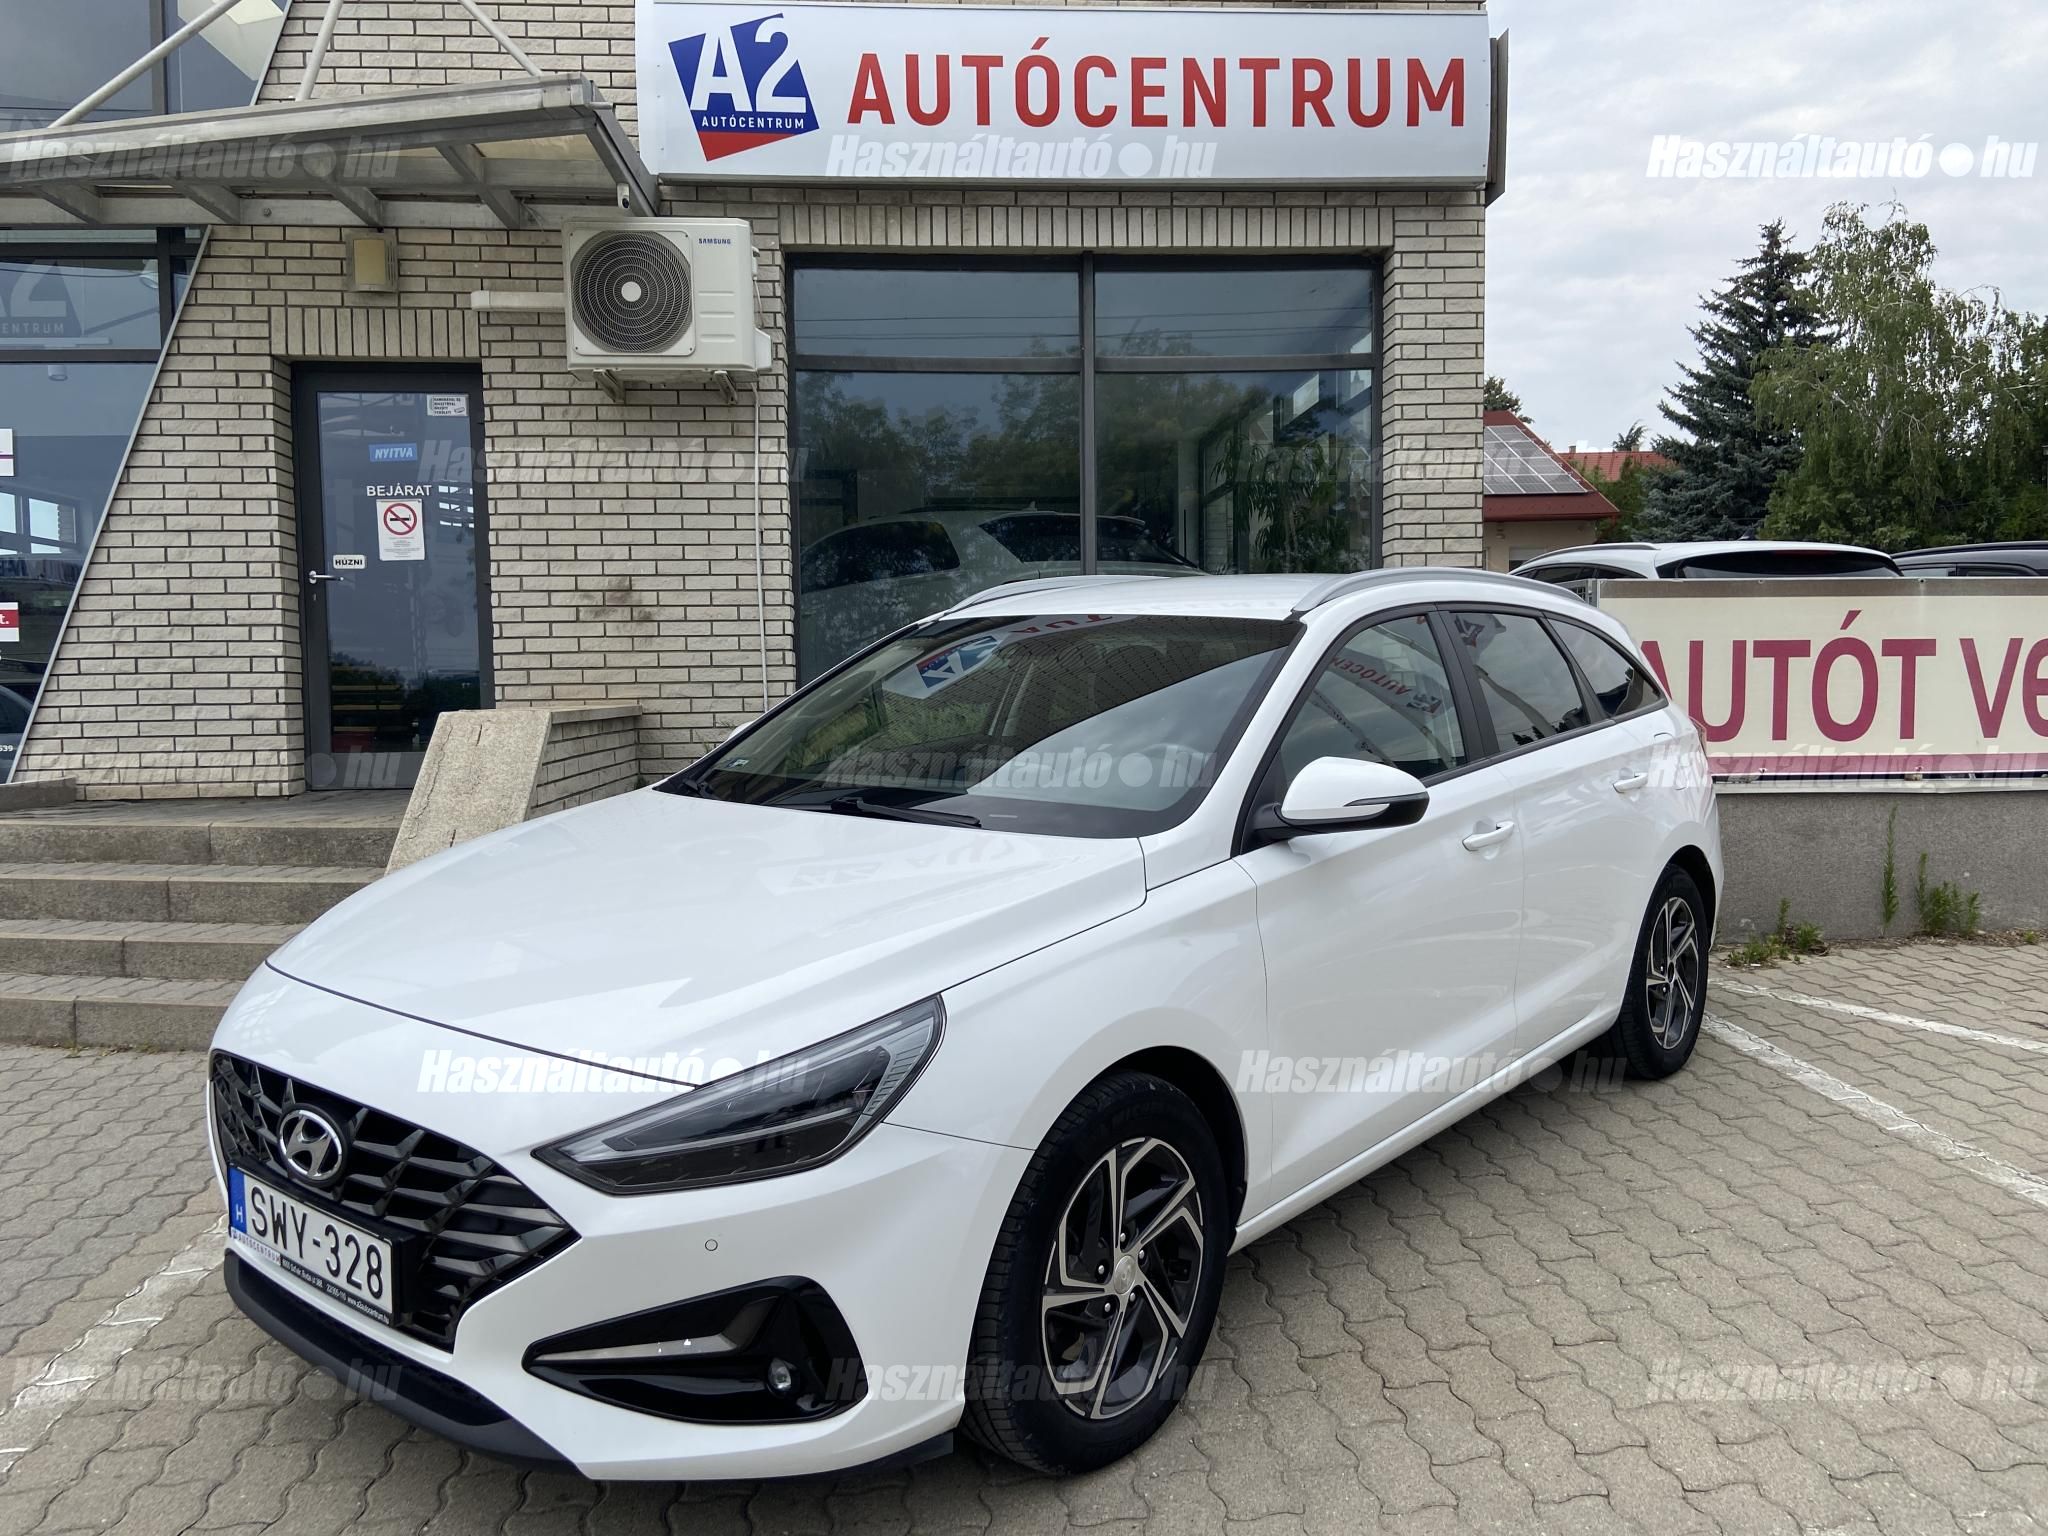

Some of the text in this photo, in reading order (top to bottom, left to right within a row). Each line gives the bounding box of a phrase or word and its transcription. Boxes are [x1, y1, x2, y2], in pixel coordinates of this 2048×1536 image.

[690, 17, 807, 113] A2
[846, 36, 1465, 128] AUTÓCENTRUM
[702, 114, 804, 129] AUTÓCENTRUM
[374, 447, 413, 460] NYITVA
[366, 483, 432, 497] BEJÁRAT
[335, 557, 363, 566] HÚZNI
[235, 1203, 244, 1223] H
[251, 1185, 384, 1301] SWY-328
